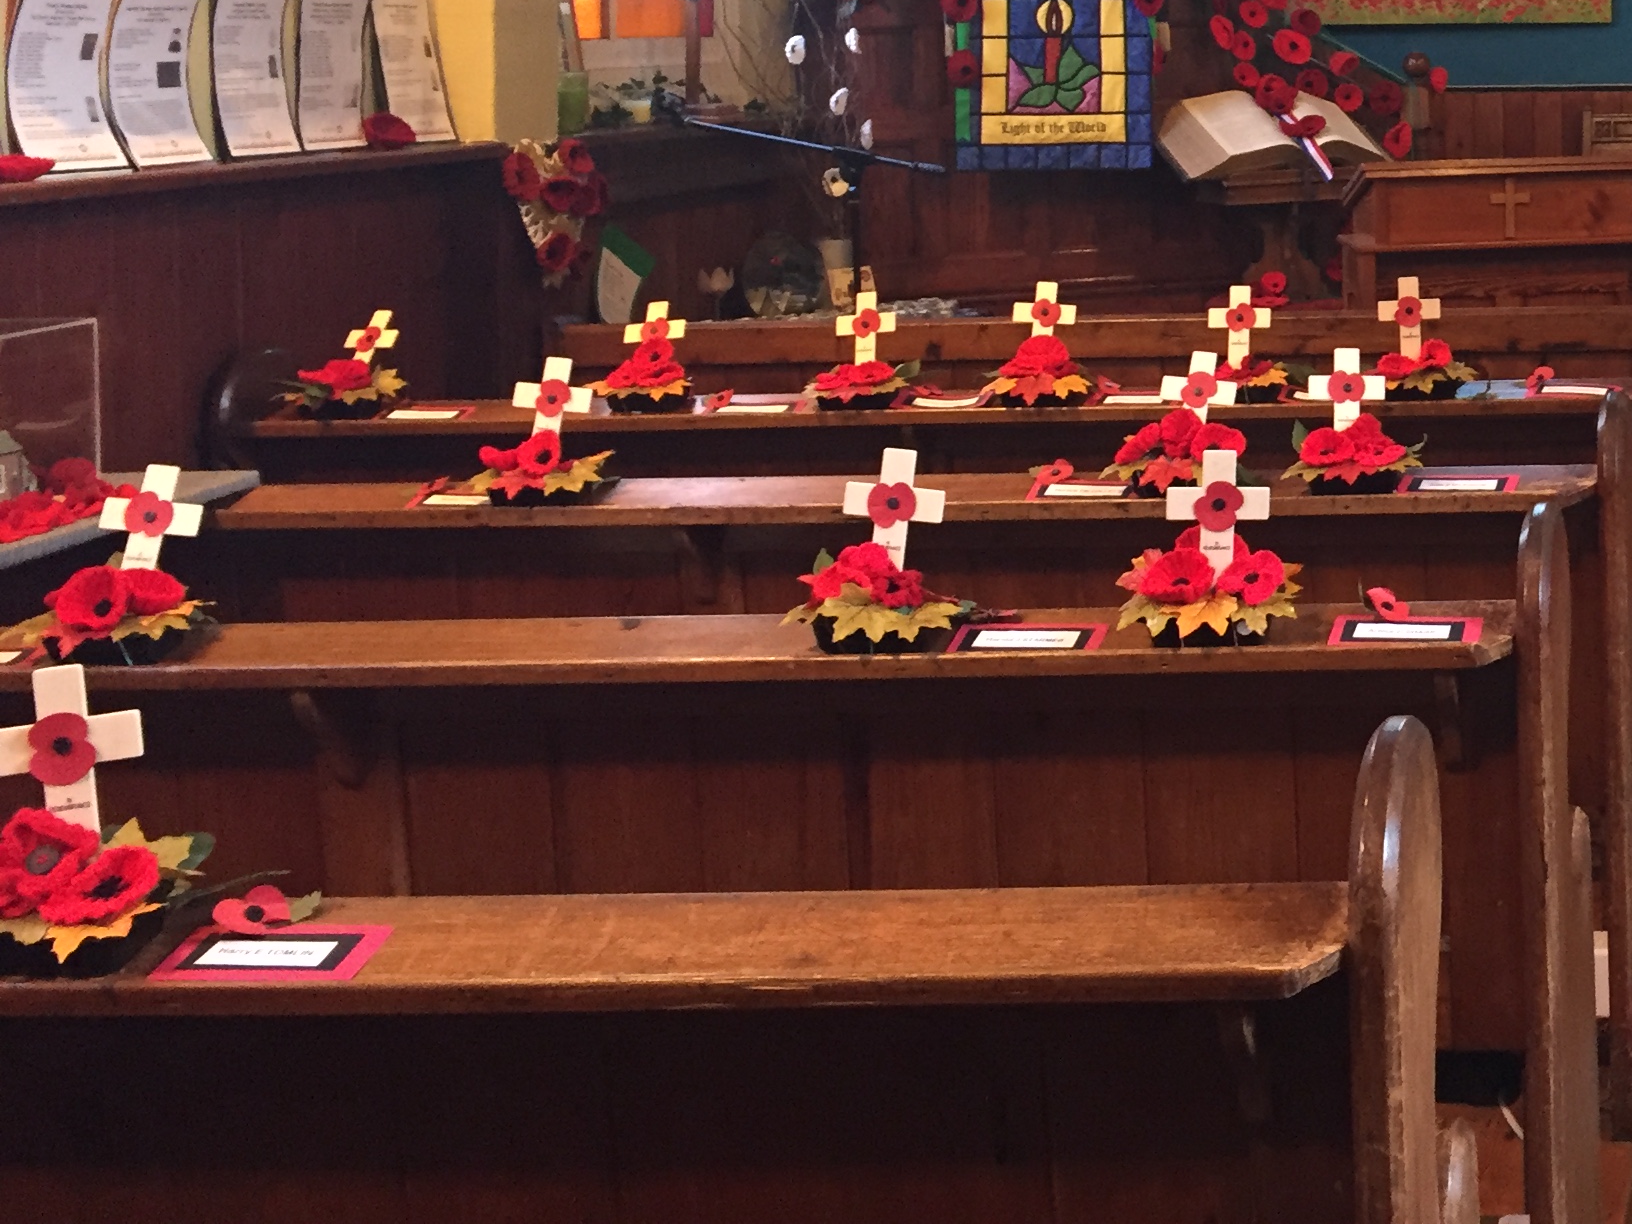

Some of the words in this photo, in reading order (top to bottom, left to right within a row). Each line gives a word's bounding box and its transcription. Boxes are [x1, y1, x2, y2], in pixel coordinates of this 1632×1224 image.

[1000, 121, 1030, 136] Light
[1034, 121, 1045, 134] of
[1049, 122, 1064, 134] the
[1068, 121, 1107, 133] World
